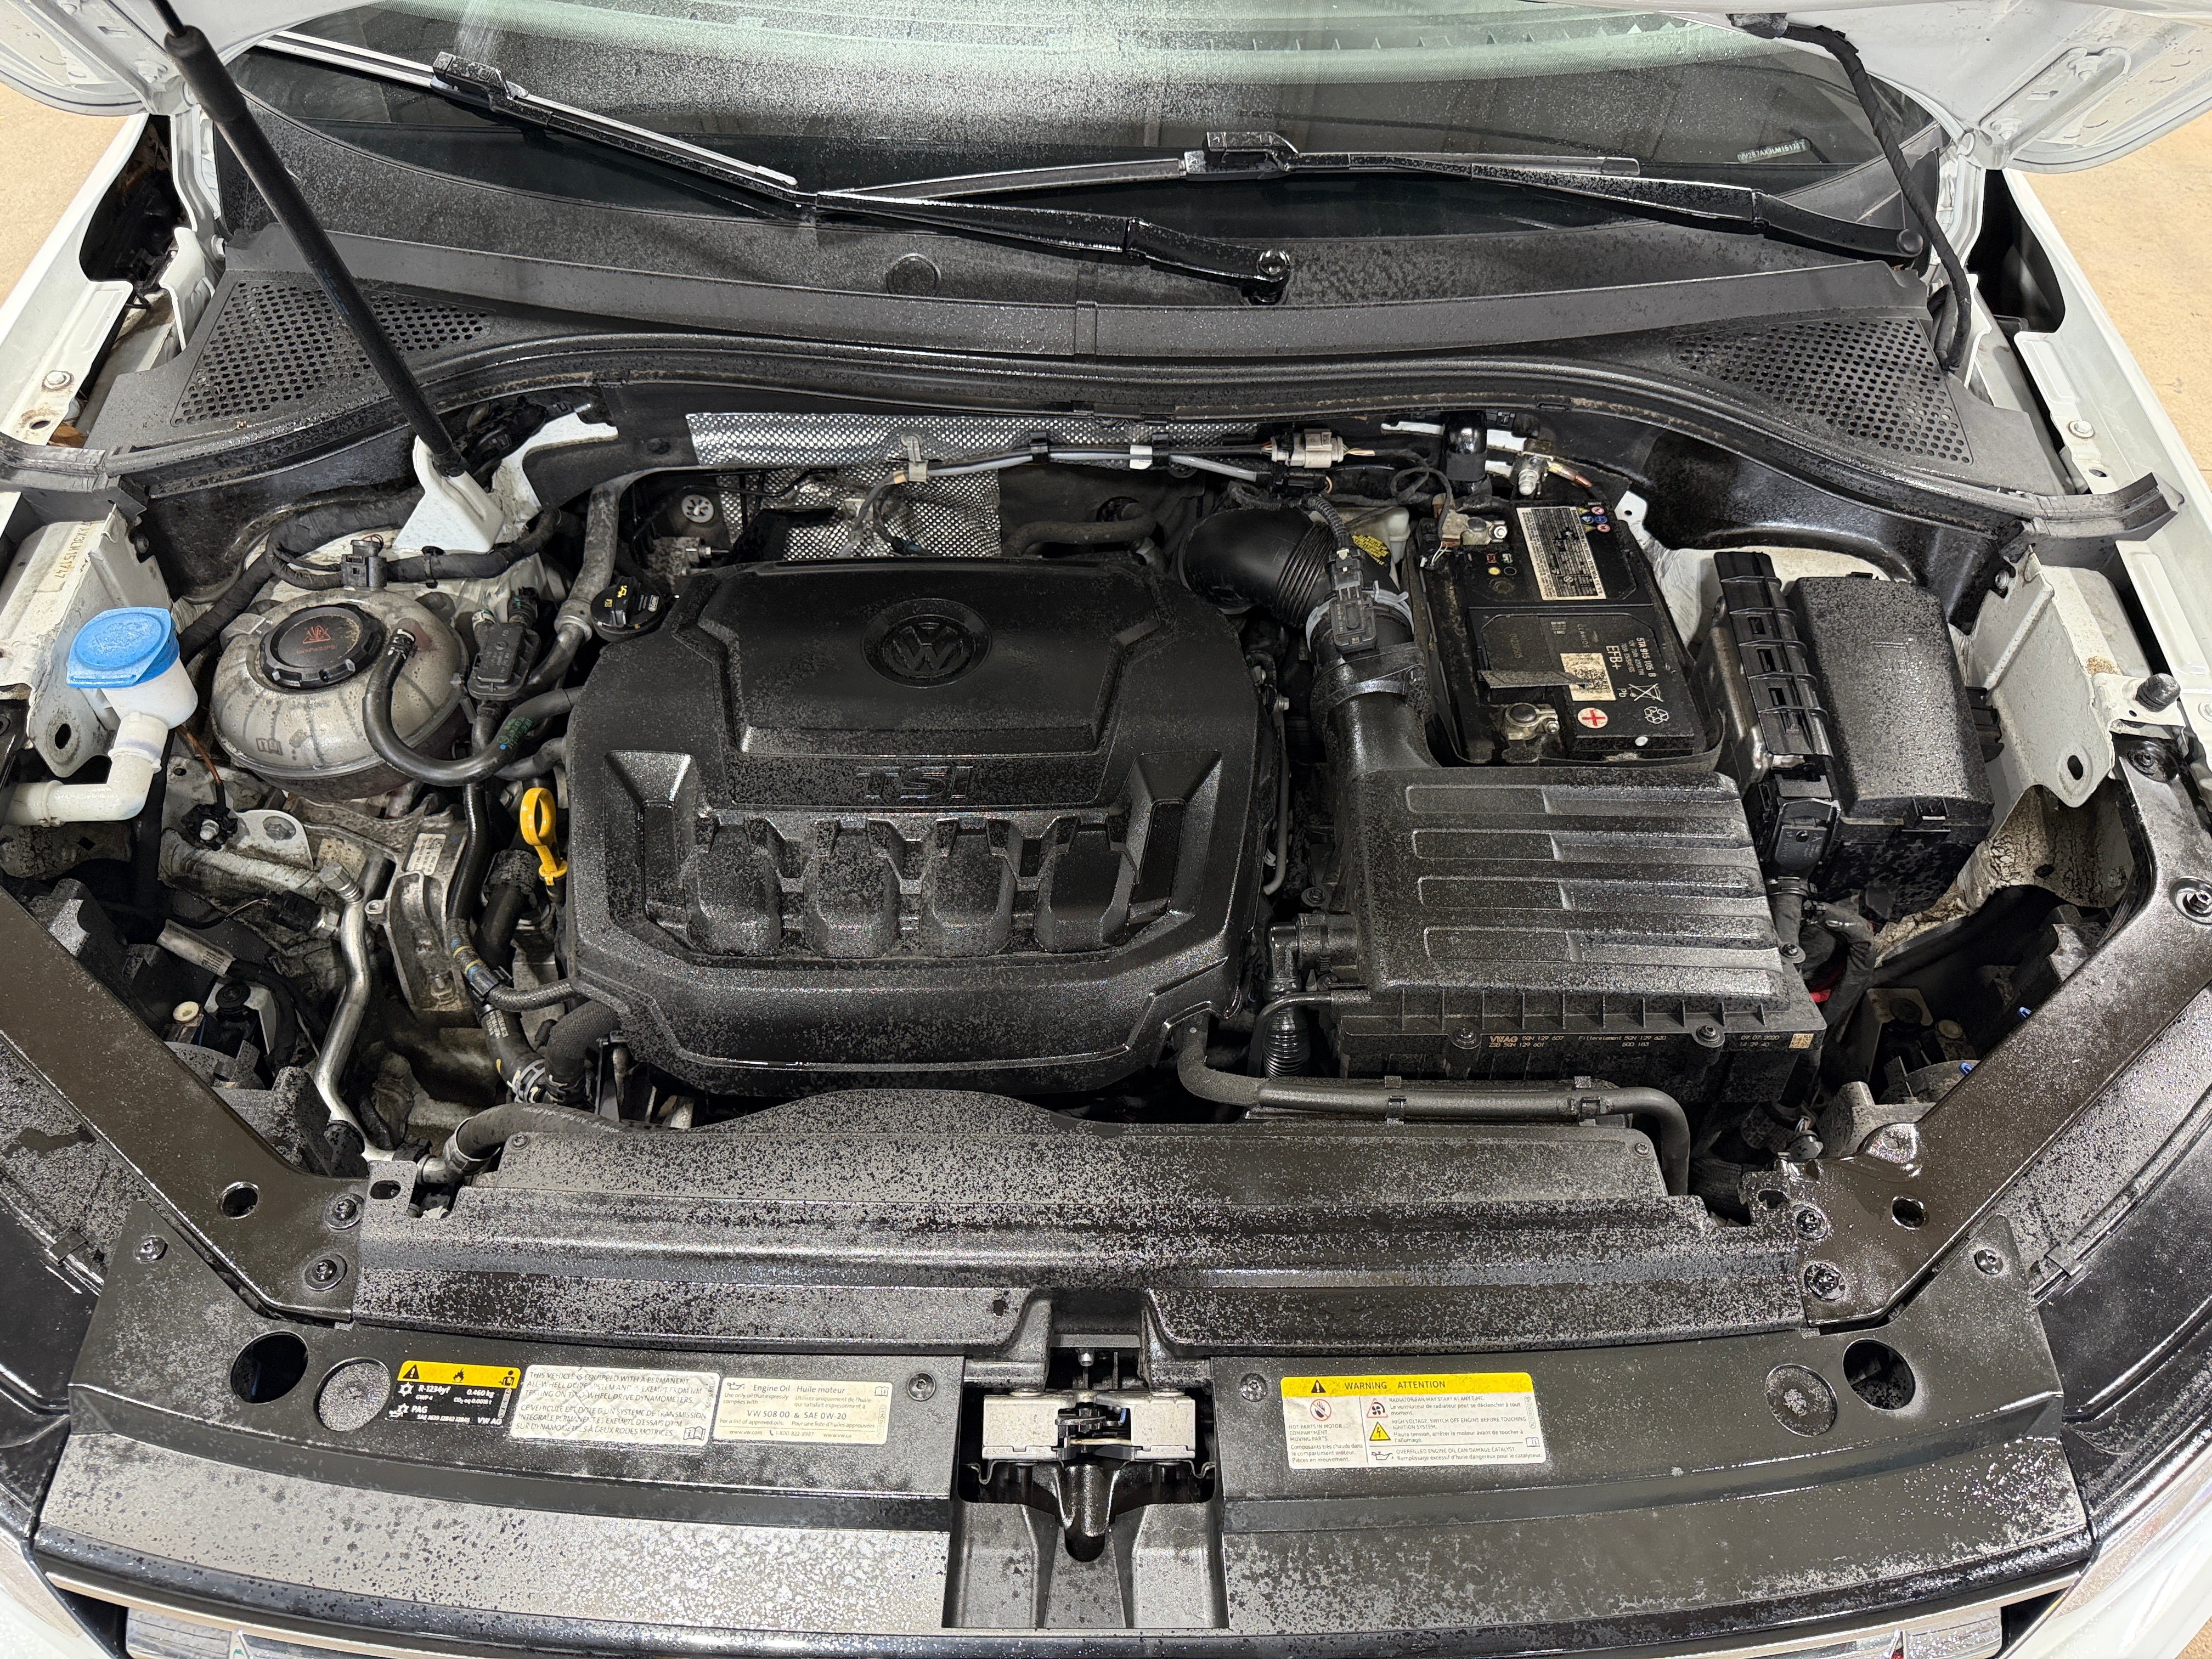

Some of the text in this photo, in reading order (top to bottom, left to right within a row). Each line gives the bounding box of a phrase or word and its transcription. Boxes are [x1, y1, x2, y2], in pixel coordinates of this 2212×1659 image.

[1577, 624, 1589, 648] CLARIOS
[1636, 637, 1646, 648] 5TA
[1606, 646, 1623, 670] EFB+
[1640, 648, 1650, 659] 915
[1617, 688, 1628, 698] Pb
[857, 766, 973, 799] TSI
[584, 1374, 619, 1382] EQUIPPED
[418, 1384, 452, 1396] R-1234yf
[753, 1384, 778, 1393] Engine
[1344, 1380, 1446, 1390] WARNING ATTENTION
[411, 1405, 428, 1414] PAG
